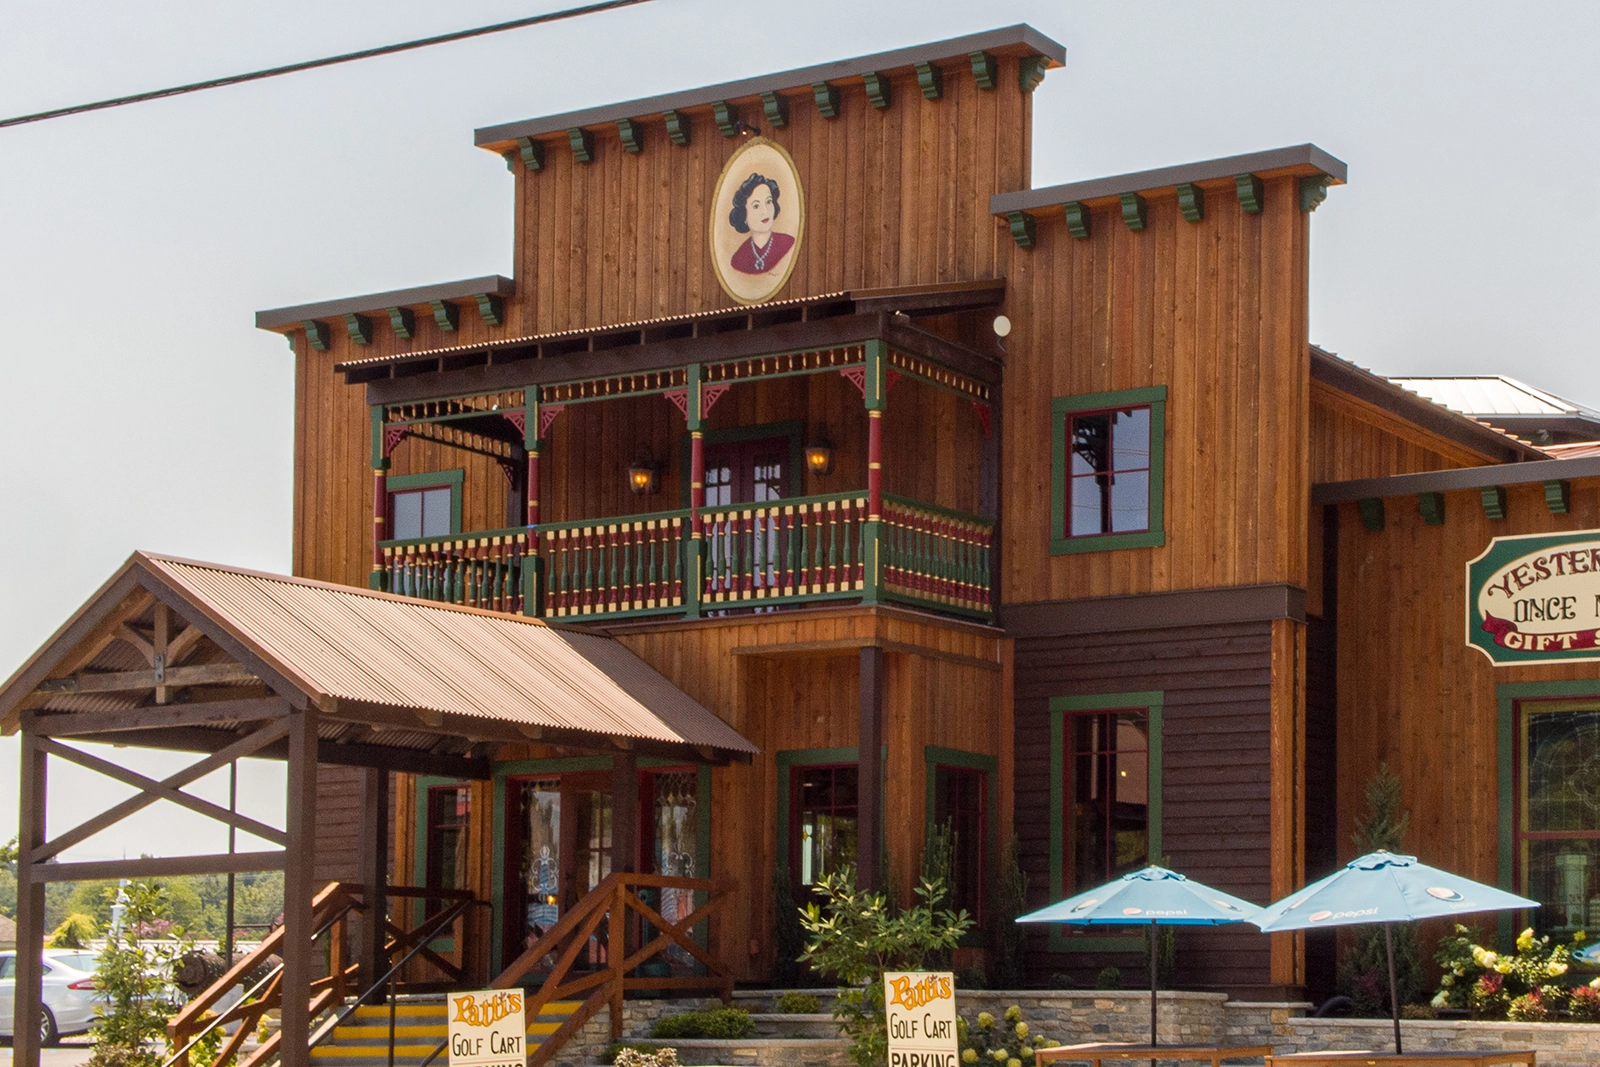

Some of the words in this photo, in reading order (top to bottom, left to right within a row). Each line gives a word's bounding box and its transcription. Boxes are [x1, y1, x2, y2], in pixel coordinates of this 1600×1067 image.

[1513, 596, 1577, 623] ONCE
[1503, 631, 1578, 651] GIFT
[1332, 906, 1379, 920] pepsi
[890, 1012, 918, 1039] GOLF
[923, 1012, 952, 1039] CART
[452, 1032, 484, 1057] GOLF
[490, 1030, 522, 1054] CART
[891, 1052, 956, 1067] PARKING
